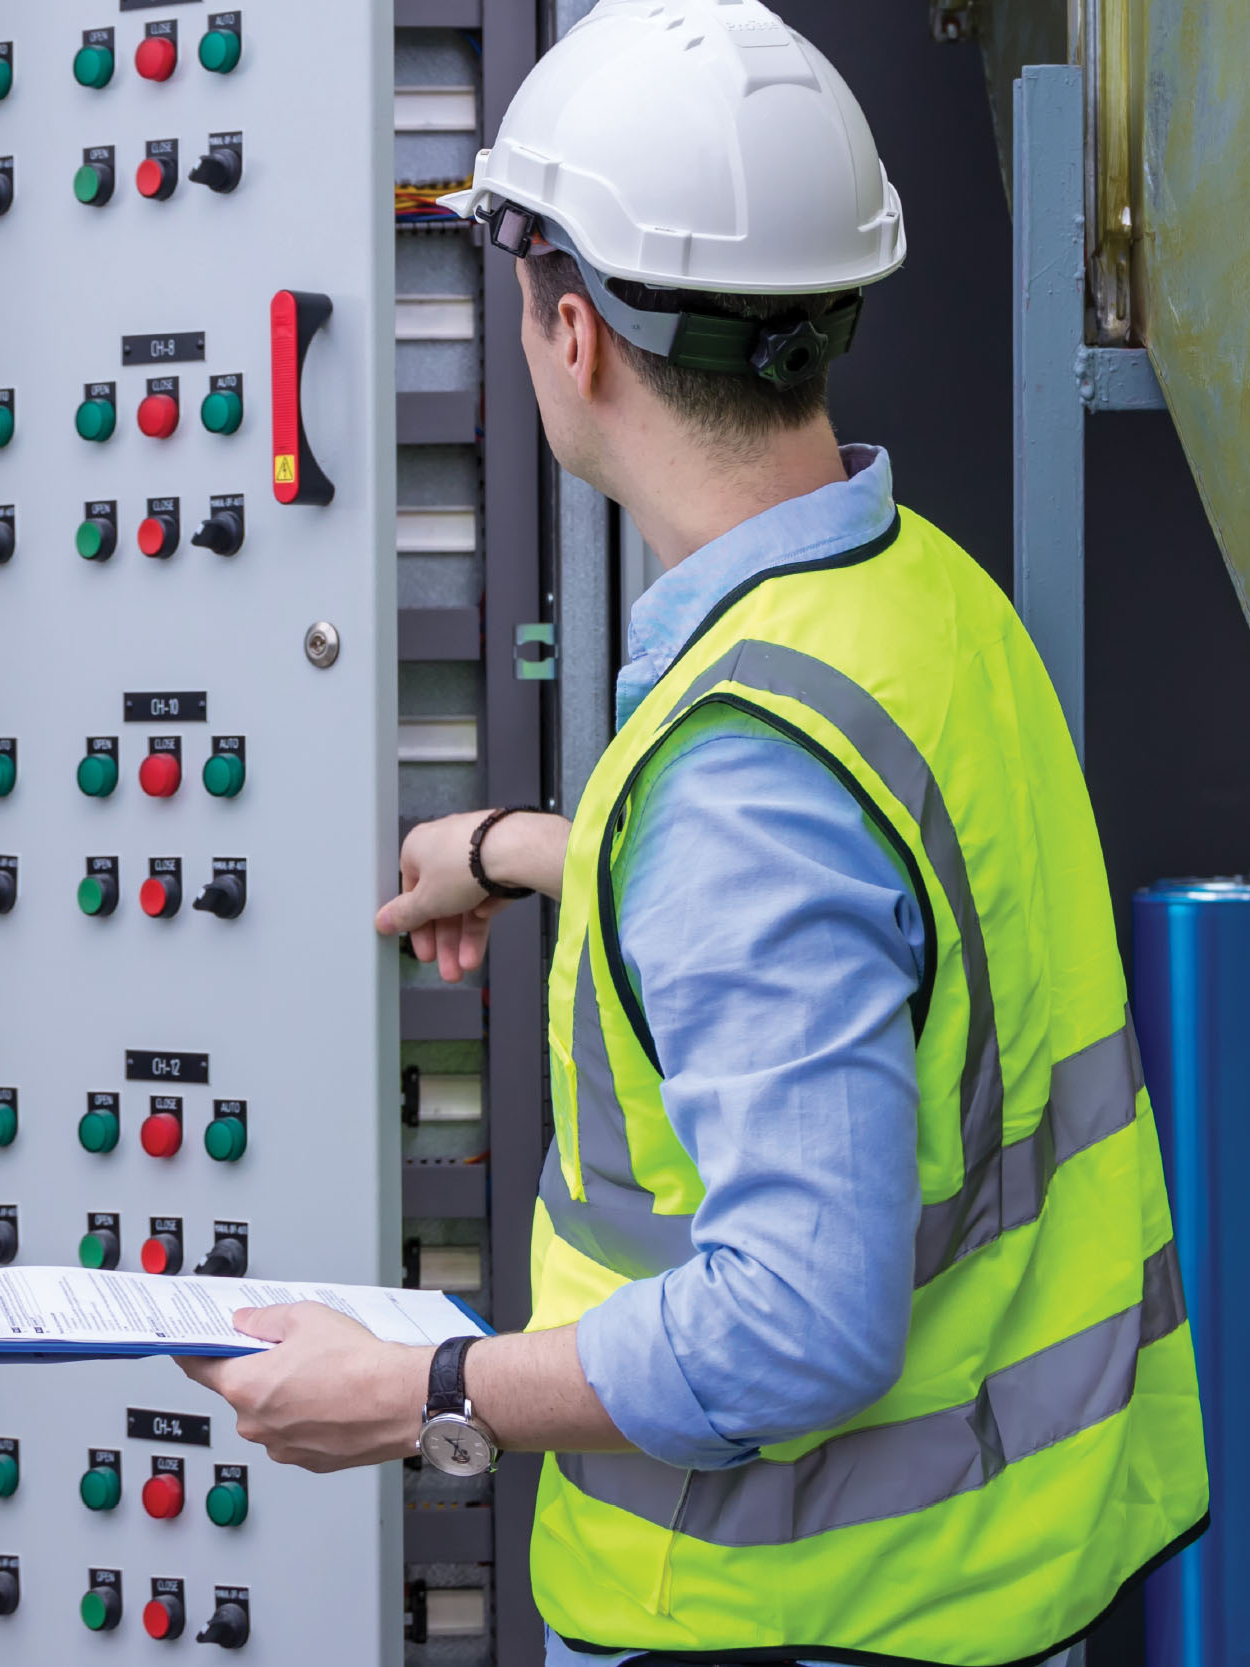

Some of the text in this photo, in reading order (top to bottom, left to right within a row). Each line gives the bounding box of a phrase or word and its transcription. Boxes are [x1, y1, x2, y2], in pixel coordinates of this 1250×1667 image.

[216, 14, 235, 25] AUTO
[150, 23, 171, 34] CLOSE
[89, 31, 109, 42] OPEN
[151, 142, 172, 153] CLOSE
[90, 149, 109, 160] OPEN
[150, 338, 176, 358] CH-8
[152, 379, 173, 391] CLOSE
[216, 376, 237, 388] AUTO
[91, 384, 110, 396] OPEN
[91, 503, 111, 514] OPEN
[152, 500, 174, 511] CLOSE
[150, 699, 179, 716] CH-10
[93, 739, 112, 749] OPEN
[154, 738, 175, 749] CLOSE
[220, 738, 239, 749] AUTO
[93, 859, 112, 870] OPEN
[154, 859, 175, 871] CLOSE
[152, 1057, 180, 1076] CH-12
[94, 1094, 114, 1105] OPEN
[155, 1098, 177, 1109] CLOSE
[220, 1102, 240, 1113] AUTO
[94, 1215, 114, 1226] OPEN
[155, 1219, 177, 1231] CLOSE
[153, 1416, 181, 1437] CH-14
[96, 1452, 115, 1462] OPEN
[157, 1458, 178, 1470] CLOSE
[221, 1467, 241, 1478] AUTO
[96, 1571, 116, 1582] OPEN
[157, 1580, 178, 1592] CLOSE
